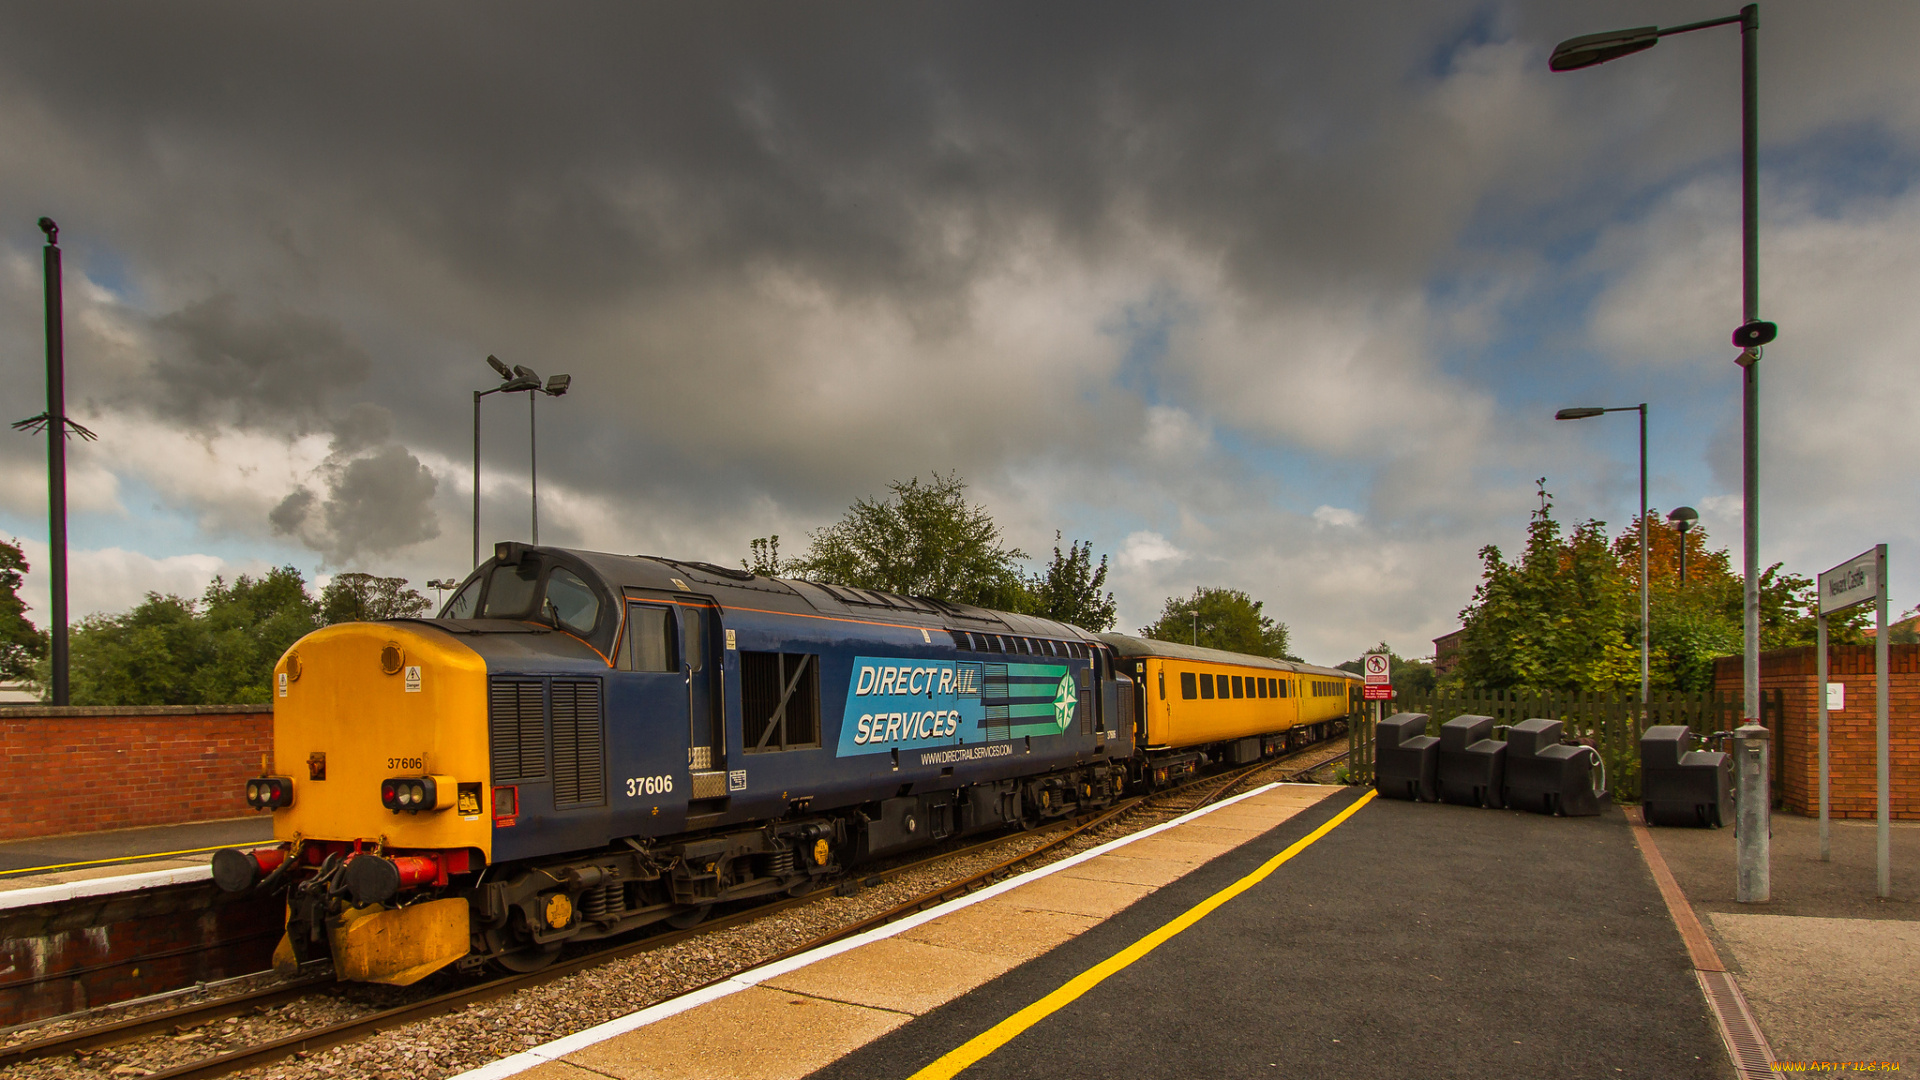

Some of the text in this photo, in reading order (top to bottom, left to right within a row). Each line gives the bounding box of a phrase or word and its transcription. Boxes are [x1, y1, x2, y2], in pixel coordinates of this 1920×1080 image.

[1829, 566, 1864, 597] Newark Castle
[855, 665, 978, 696] DIRECT RAIL
[854, 709, 959, 746] SERVICES
[387, 757, 422, 769] 37606
[920, 744, 1013, 766] WWW.DIRECTRAILSERVICES.COM
[626, 774, 673, 797] 37606
